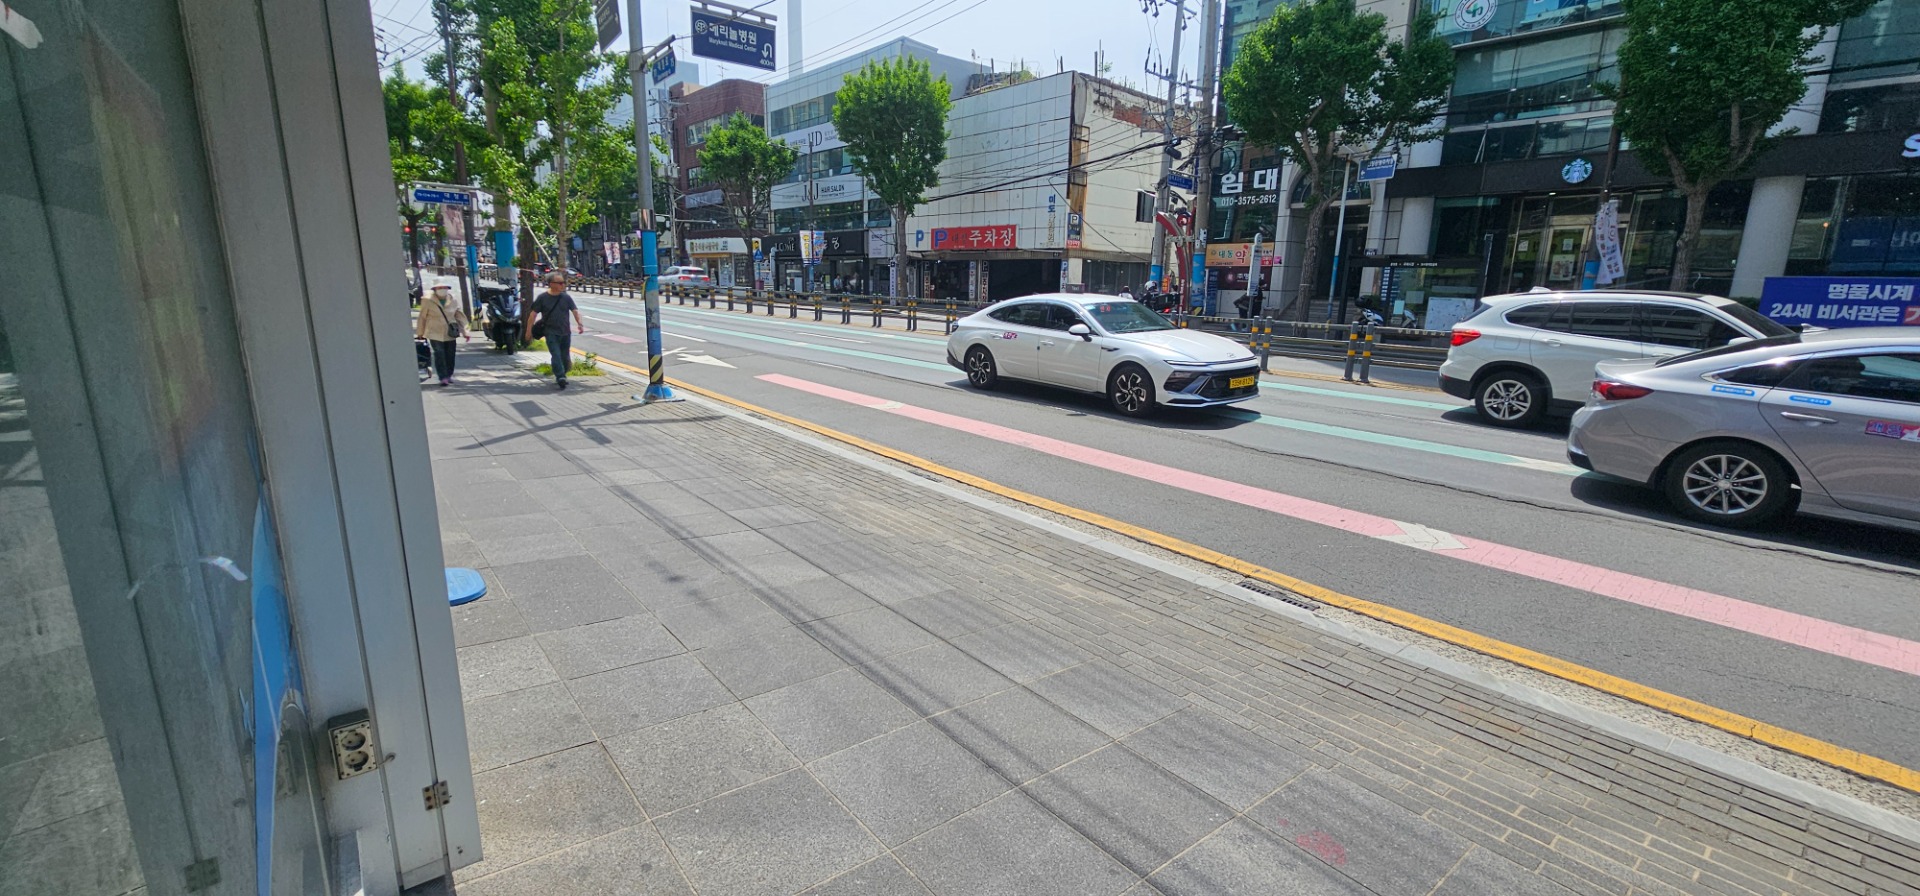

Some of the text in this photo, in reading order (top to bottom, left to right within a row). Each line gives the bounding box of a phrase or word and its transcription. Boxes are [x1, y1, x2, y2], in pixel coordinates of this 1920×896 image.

[759, 59, 775, 67] 400m
[1221, 167, 1279, 195] 임대
[1221, 194, 1277, 206] 010-3575-2612
[915, 229, 925, 248] P
[934, 229, 948, 249] P
[968, 228, 1014, 247] 주차장
[1828, 283, 1914, 301] 명품시계
[1769, 302, 1813, 319] 24세
[1816, 304, 1900, 322] 비서관은
